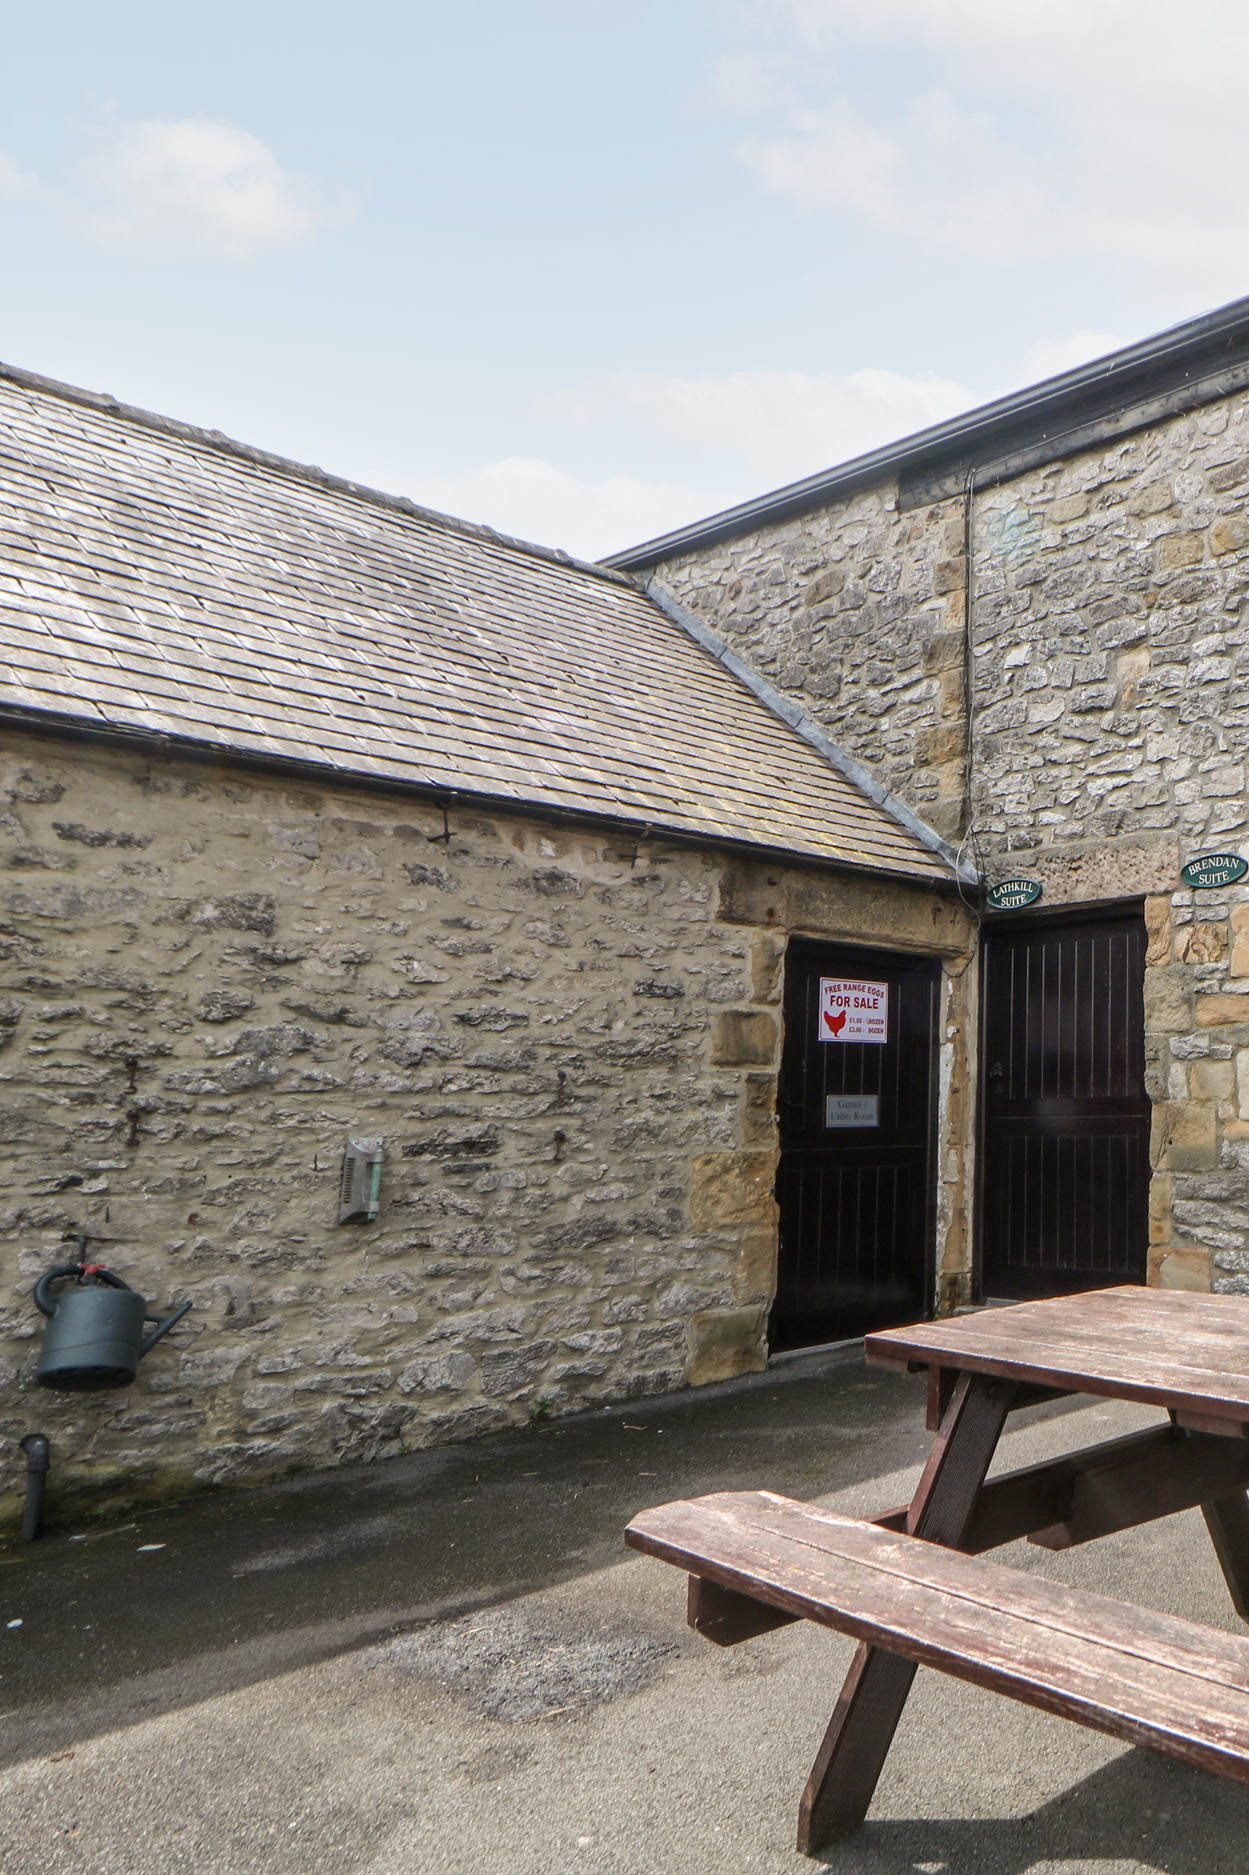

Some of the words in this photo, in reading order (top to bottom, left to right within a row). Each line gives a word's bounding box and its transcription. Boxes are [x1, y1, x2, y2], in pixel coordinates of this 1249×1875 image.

[1188, 856, 1240, 876] BRENDAN
[1198, 870, 1230, 885] SUITE
[992, 881, 1034, 899] LATHKILL
[1000, 893, 1027, 907] SUITE
[824, 984, 842, 995] FREE
[843, 983, 866, 993] RANGE
[867, 986, 885, 999] EGGS
[830, 995, 851, 1008] FOR
[853, 996, 879, 1009] SALE
[854, 1112, 875, 1120] Room
